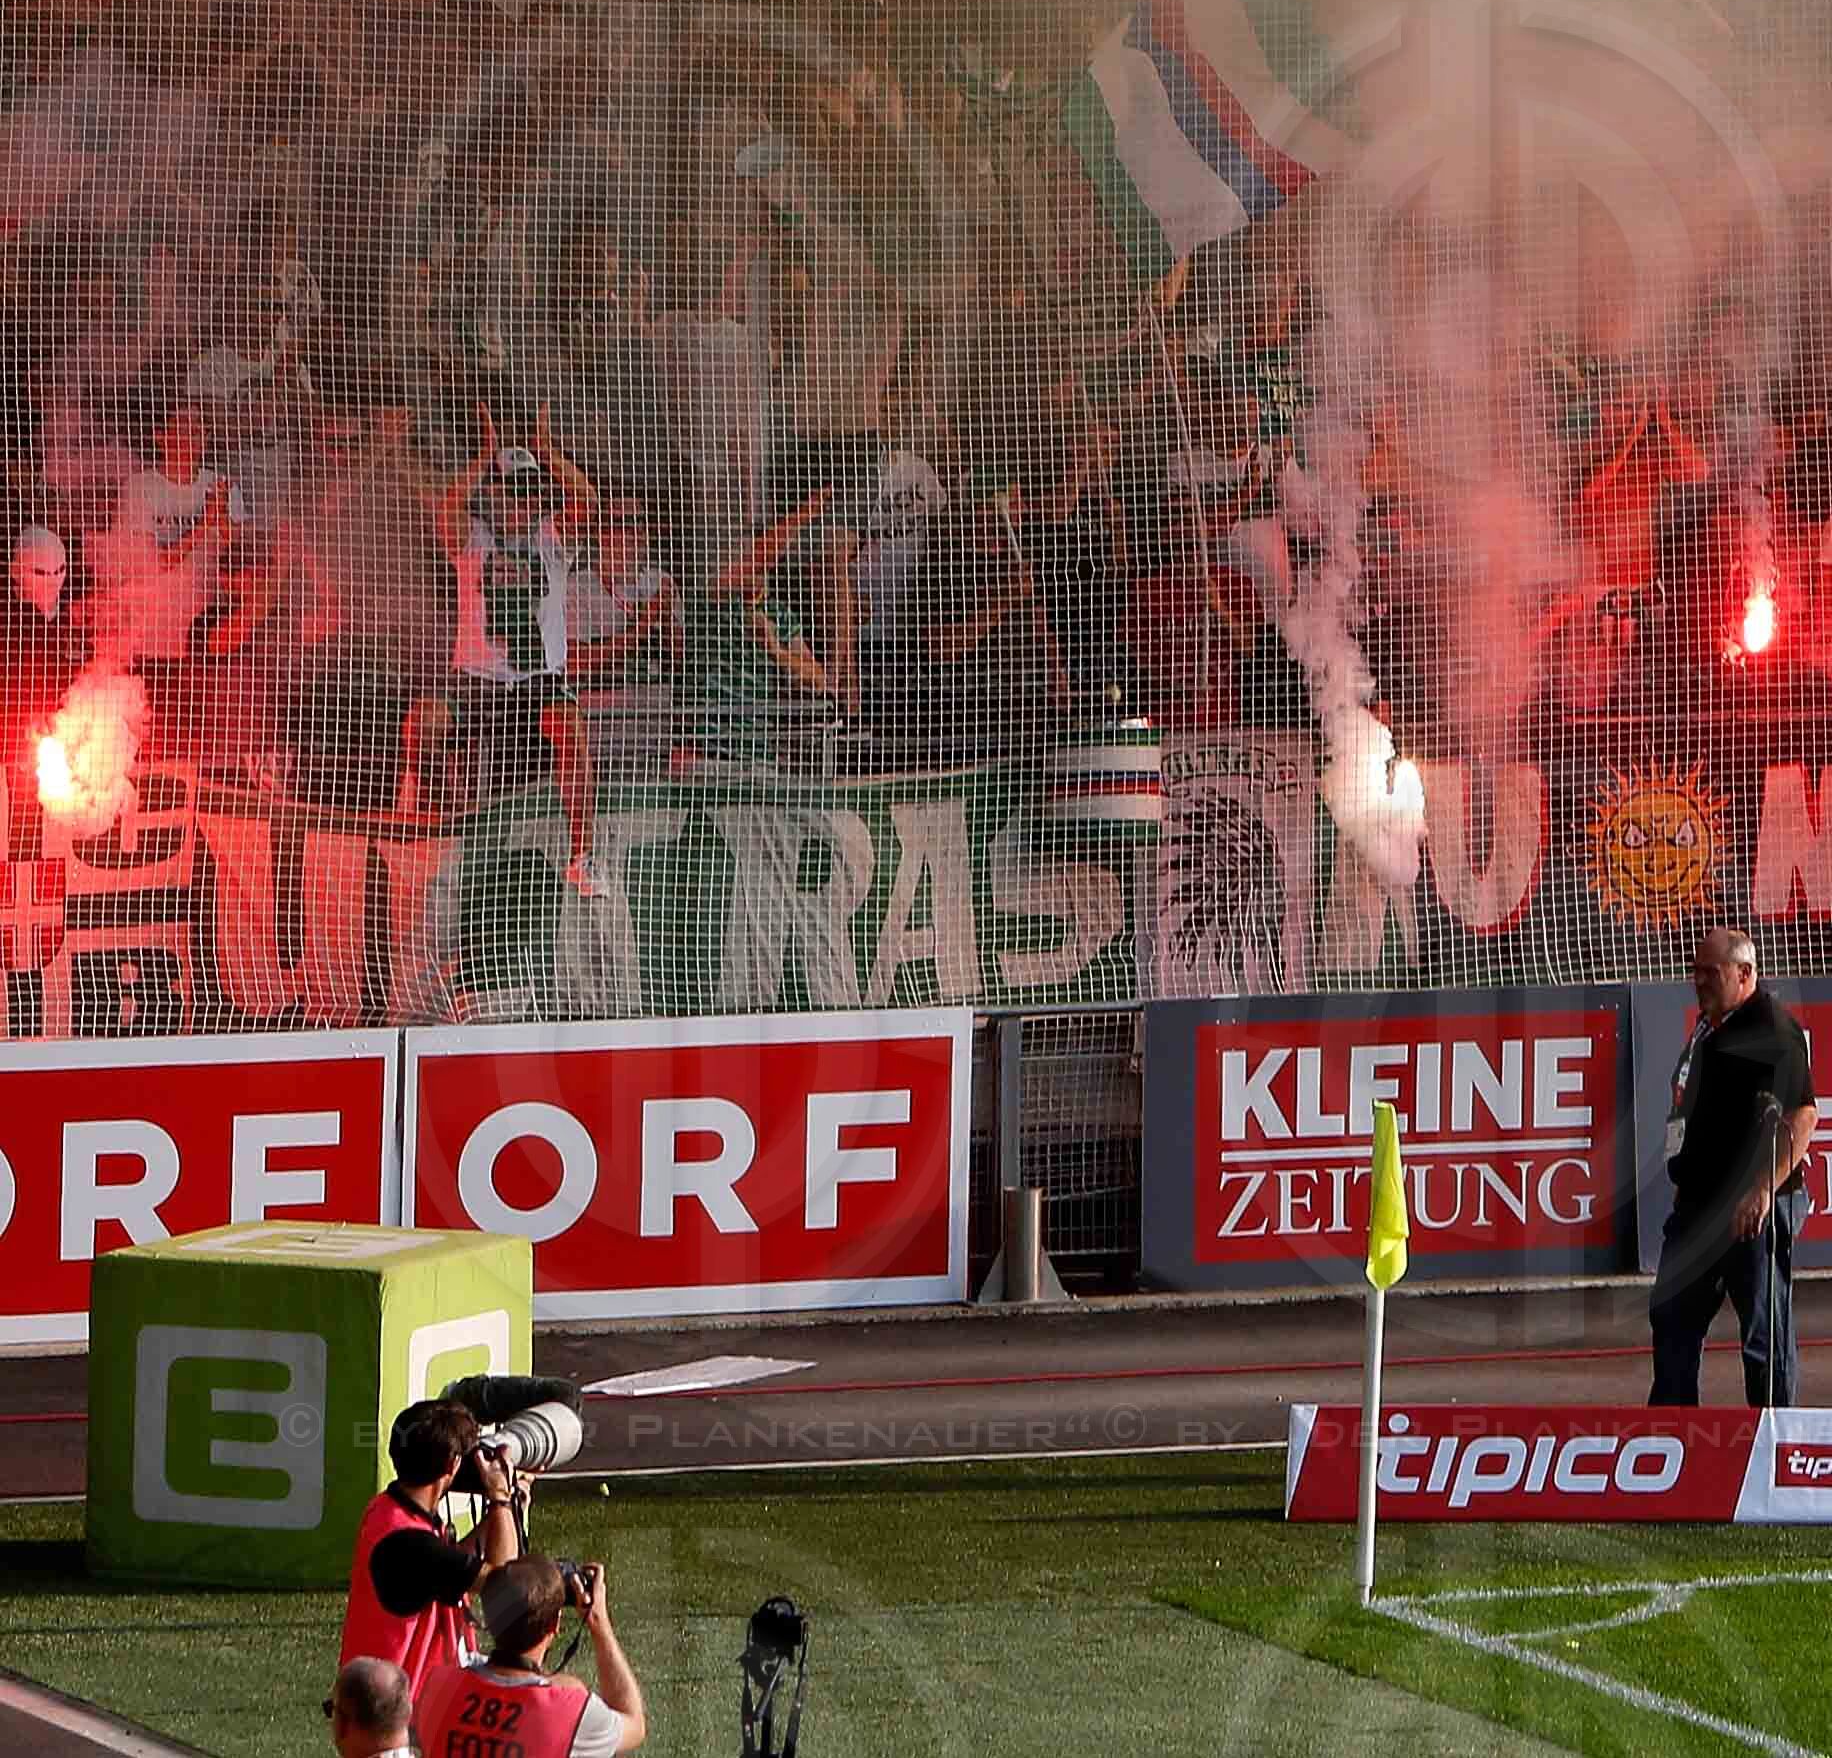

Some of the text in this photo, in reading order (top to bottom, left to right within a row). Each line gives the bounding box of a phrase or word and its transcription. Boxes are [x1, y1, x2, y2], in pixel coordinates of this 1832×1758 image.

[1220, 1038, 1593, 1140] KLEINE
[0, 1111, 341, 1262] RF
[457, 1090, 912, 1241] ORF
[1216, 1153, 1596, 1241] ZEIUNG
[1376, 1413, 1684, 1508] tipico
[459, 1692, 525, 1734] 282
